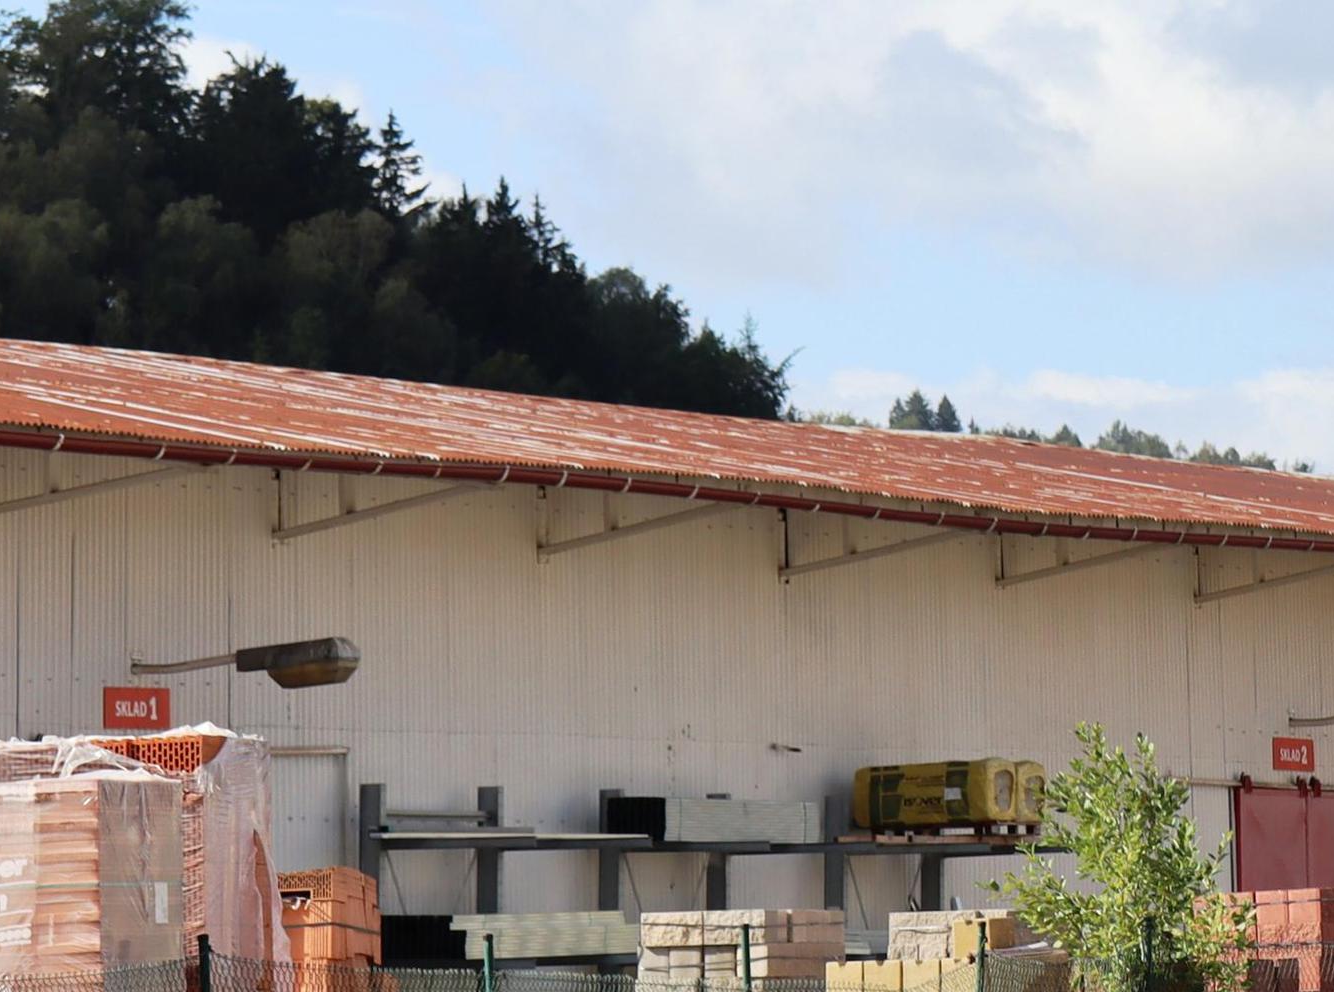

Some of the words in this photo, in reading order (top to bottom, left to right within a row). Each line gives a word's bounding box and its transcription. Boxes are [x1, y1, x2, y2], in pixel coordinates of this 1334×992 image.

[115, 700, 147, 717] SKLAD
[149, 697, 158, 720] 1
[1280, 748, 1300, 762] SKLAD
[1301, 745, 1308, 764] 2
